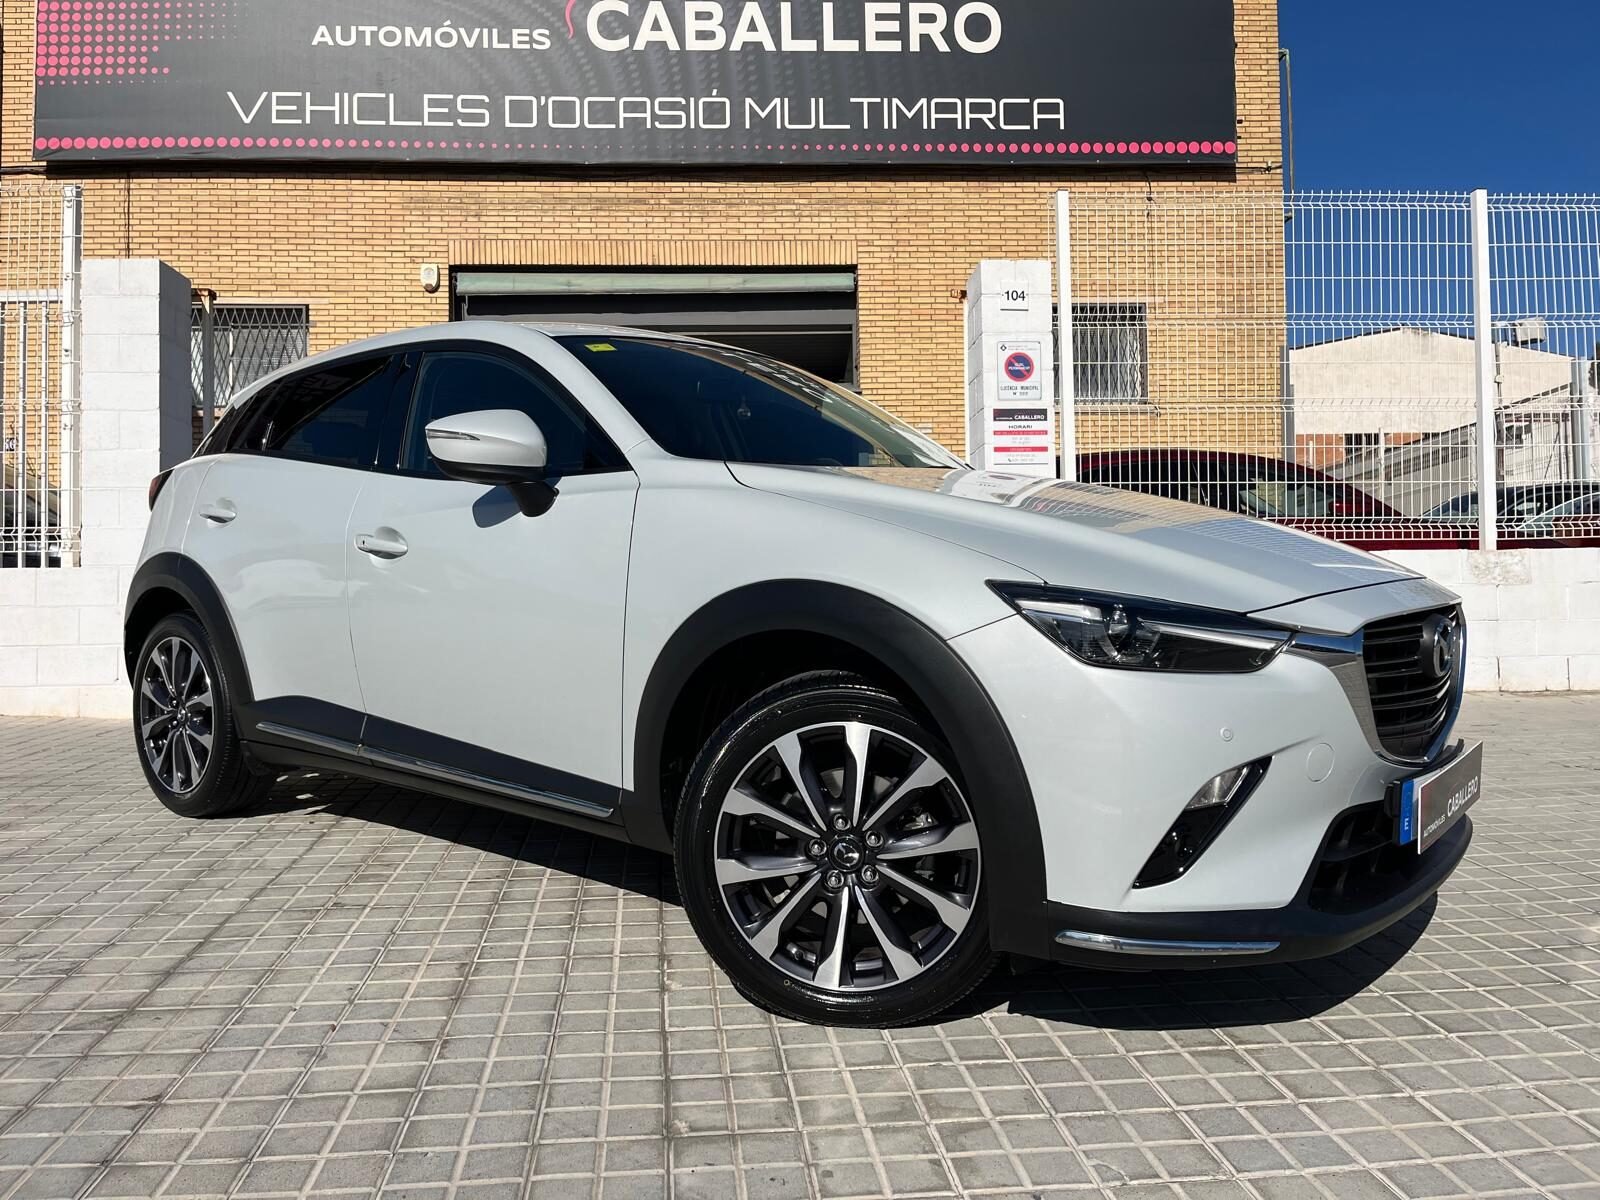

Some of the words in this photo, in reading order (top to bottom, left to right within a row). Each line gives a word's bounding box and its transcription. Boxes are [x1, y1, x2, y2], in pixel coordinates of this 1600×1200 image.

[311, 20, 552, 50] AUTOMÓVILES
[586, 0, 1003, 54] CABALLERO
[226, 91, 490, 128] VEHICLES
[504, 88, 732, 131] D'OCASIÓ
[744, 97, 1066, 131] MULTIMARCA
[1004, 290, 1026, 301] 104
[1447, 775, 1479, 817] CABALLERO
